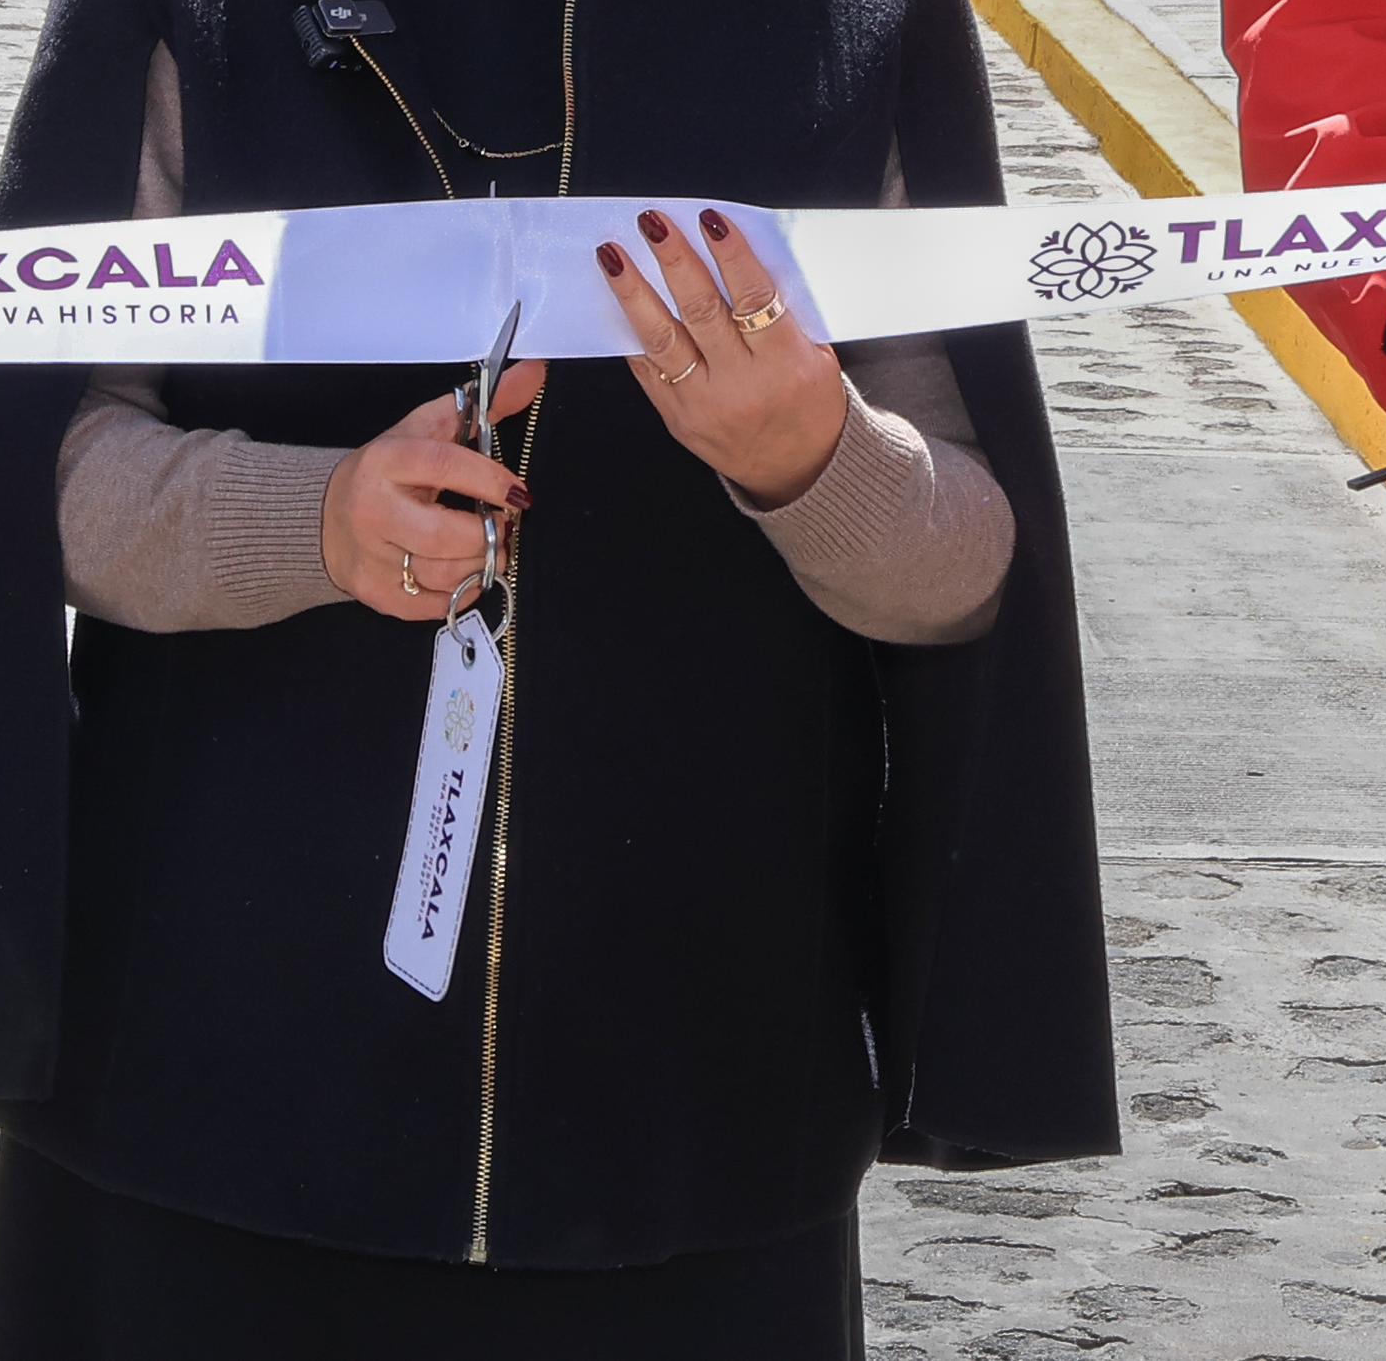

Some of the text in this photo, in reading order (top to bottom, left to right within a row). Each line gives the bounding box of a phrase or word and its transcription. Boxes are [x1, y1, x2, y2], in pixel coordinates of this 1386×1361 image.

[1207, 265, 1278, 281] UNA
[59, 303, 240, 325] HISTORIA
[421, 769, 465, 940] TLAXCALA
